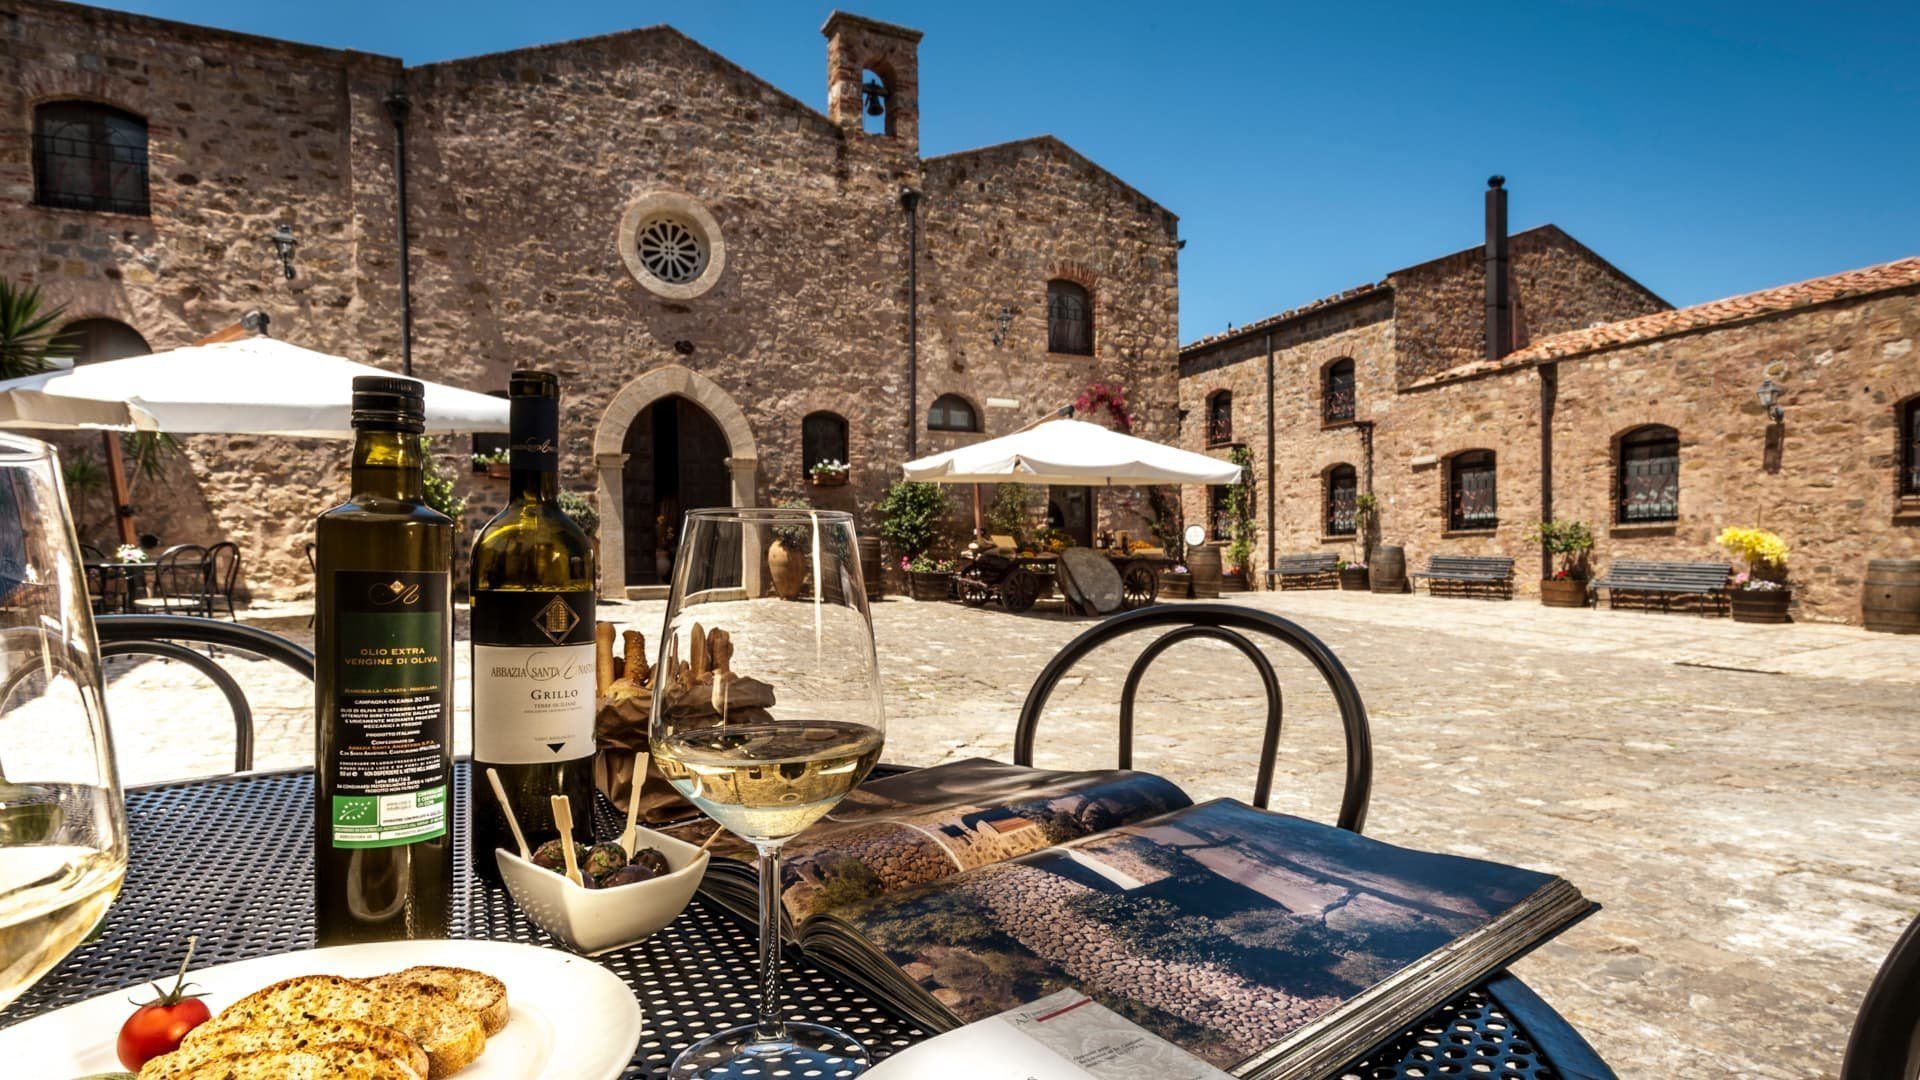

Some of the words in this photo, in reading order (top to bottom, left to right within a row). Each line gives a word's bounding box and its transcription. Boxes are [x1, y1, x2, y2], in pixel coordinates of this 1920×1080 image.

[360, 648, 388, 656] OLIO
[391, 647, 425, 656] EXTRA
[345, 657, 393, 666] VERGINE
[397, 657, 408, 665] DI
[410, 656, 439, 664] OLIVA
[490, 667, 527, 678] ABBAZIA
[532, 667, 561, 678] SANTA
[530, 689, 578, 701] GRILLO
